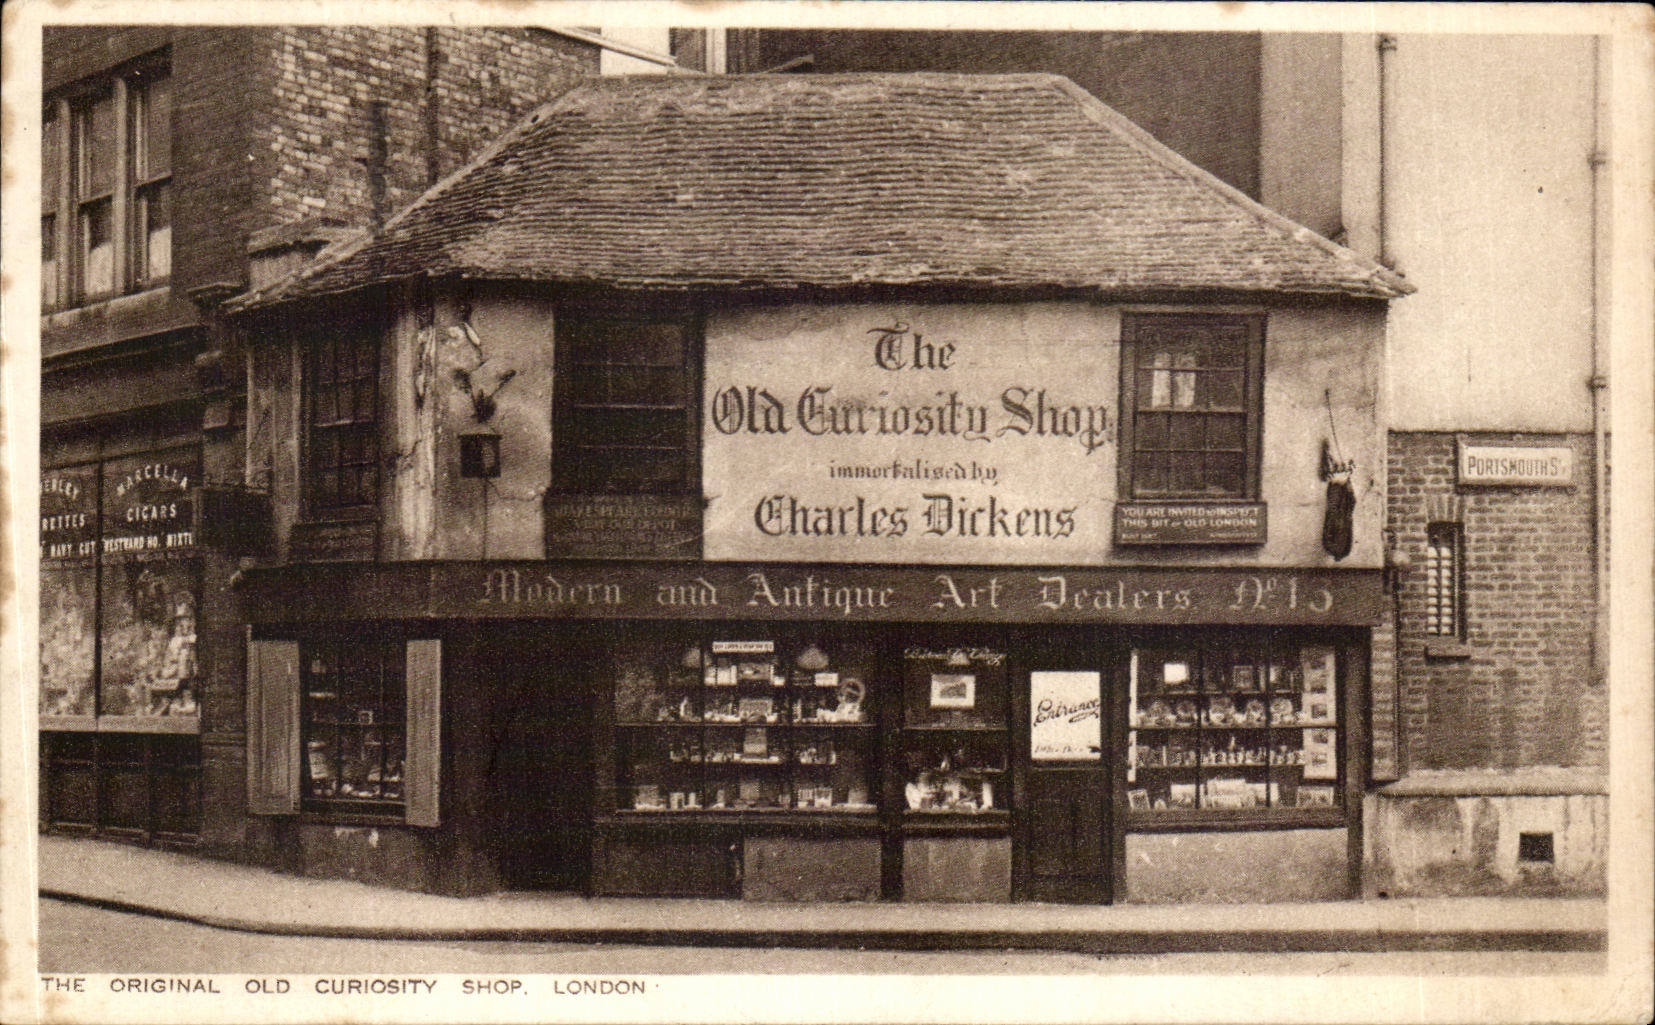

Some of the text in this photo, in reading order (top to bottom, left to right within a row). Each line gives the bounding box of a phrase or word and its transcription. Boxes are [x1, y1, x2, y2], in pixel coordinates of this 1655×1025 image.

[867, 321, 956, 371] The
[712, 385, 792, 435] Old
[797, 384, 992, 443] Curiosity
[117, 463, 188, 497] MARCELLA
[830, 458, 998, 486] immortalised by
[1468, 456, 1548, 476] PORTSMOUTH
[126, 503, 177, 522] CIGARS
[754, 493, 1077, 538] Charles Dickens
[1121, 519, 1148, 528] THIS
[1151, 519, 1169, 528] BIT
[1184, 519, 1206, 528] OLD
[1210, 519, 1257, 528] LONDON
[1122, 507, 1144, 516] YOU
[1146, 507, 1166, 516] ARE
[1168, 507, 1205, 517] INVITED
[1217, 507, 1258, 516] INSPECT
[479, 568, 622, 605] Modern
[656, 576, 719, 606] and
[744, 573, 896, 616] Antique
[931, 575, 1003, 609] Art
[1037, 576, 1192, 611] Dealers
